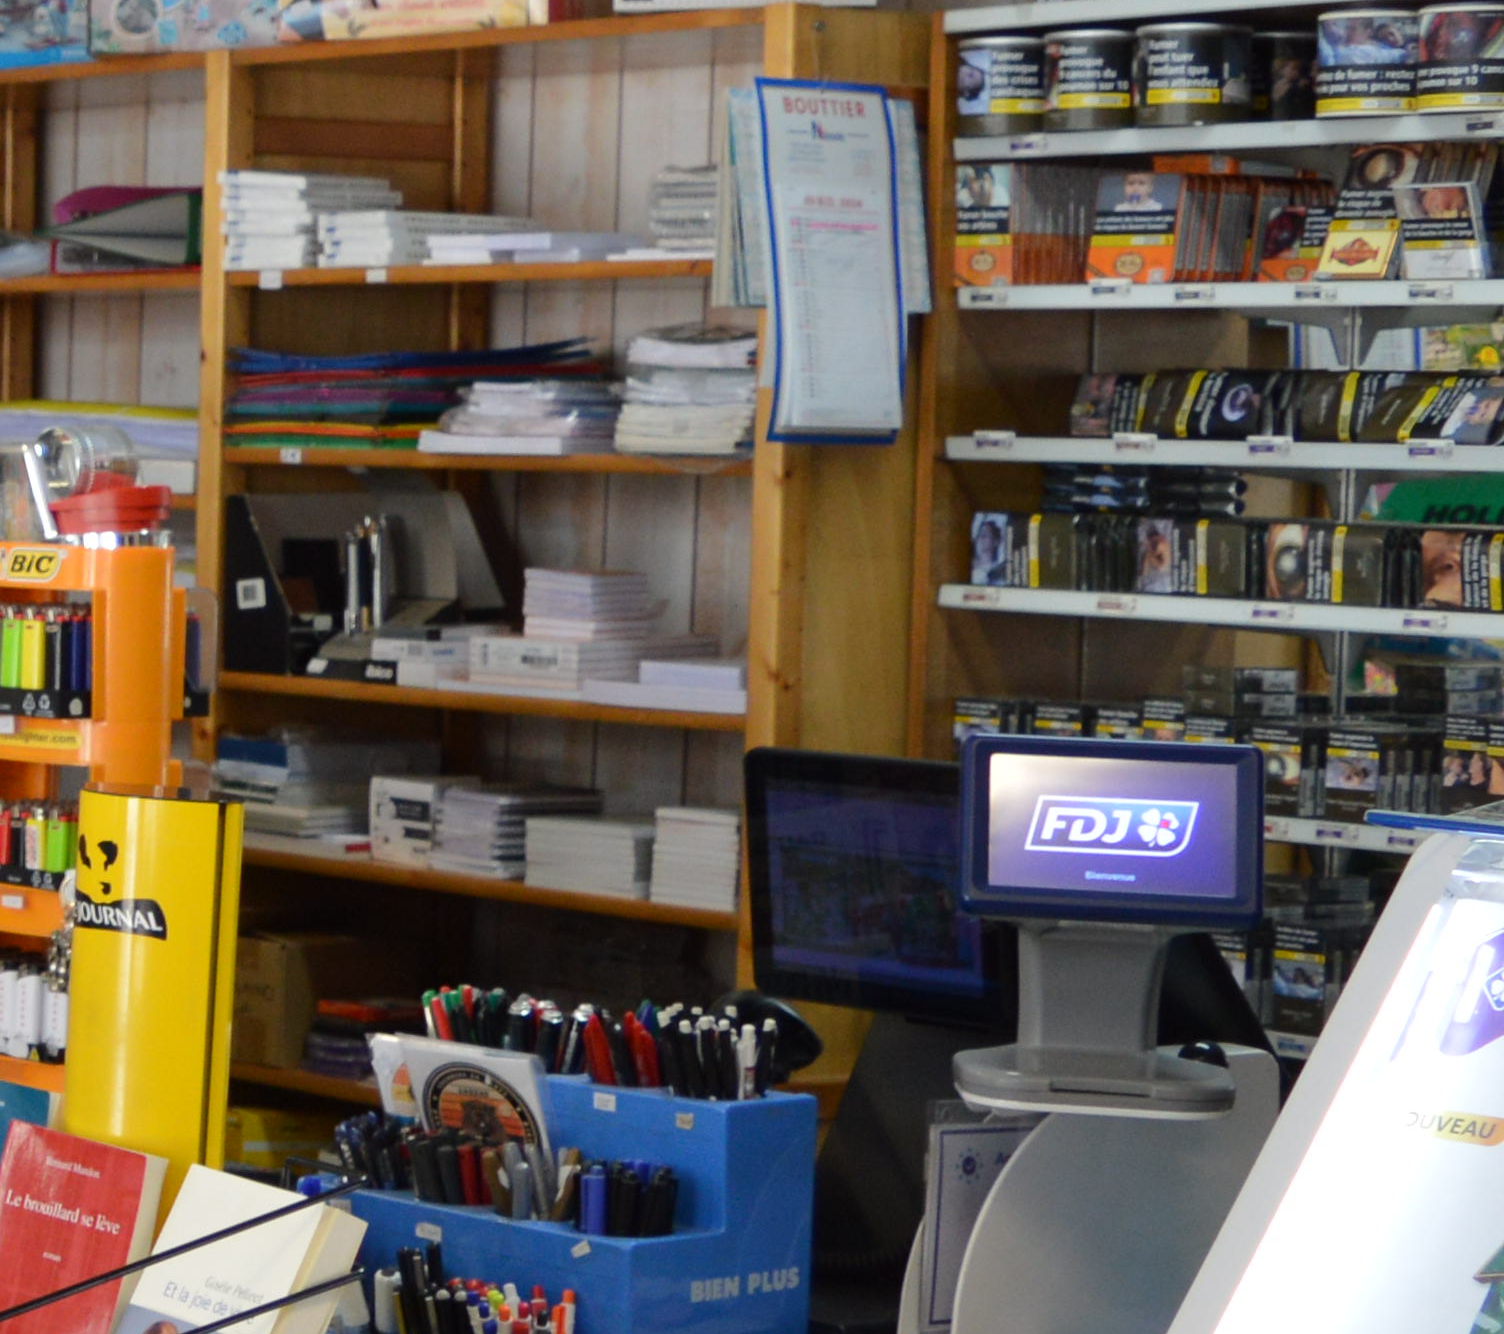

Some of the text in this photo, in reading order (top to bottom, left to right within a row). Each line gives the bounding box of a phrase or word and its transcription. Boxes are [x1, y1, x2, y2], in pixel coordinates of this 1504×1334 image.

[782, 96, 866, 119] BOUTTIER
[1040, 806, 1133, 844] FDJ
[5, 1189, 120, 1236] Le brouillard se lève
[163, 1281, 228, 1315] Et la joie de
[691, 1268, 800, 1304] BIEN PLUS
